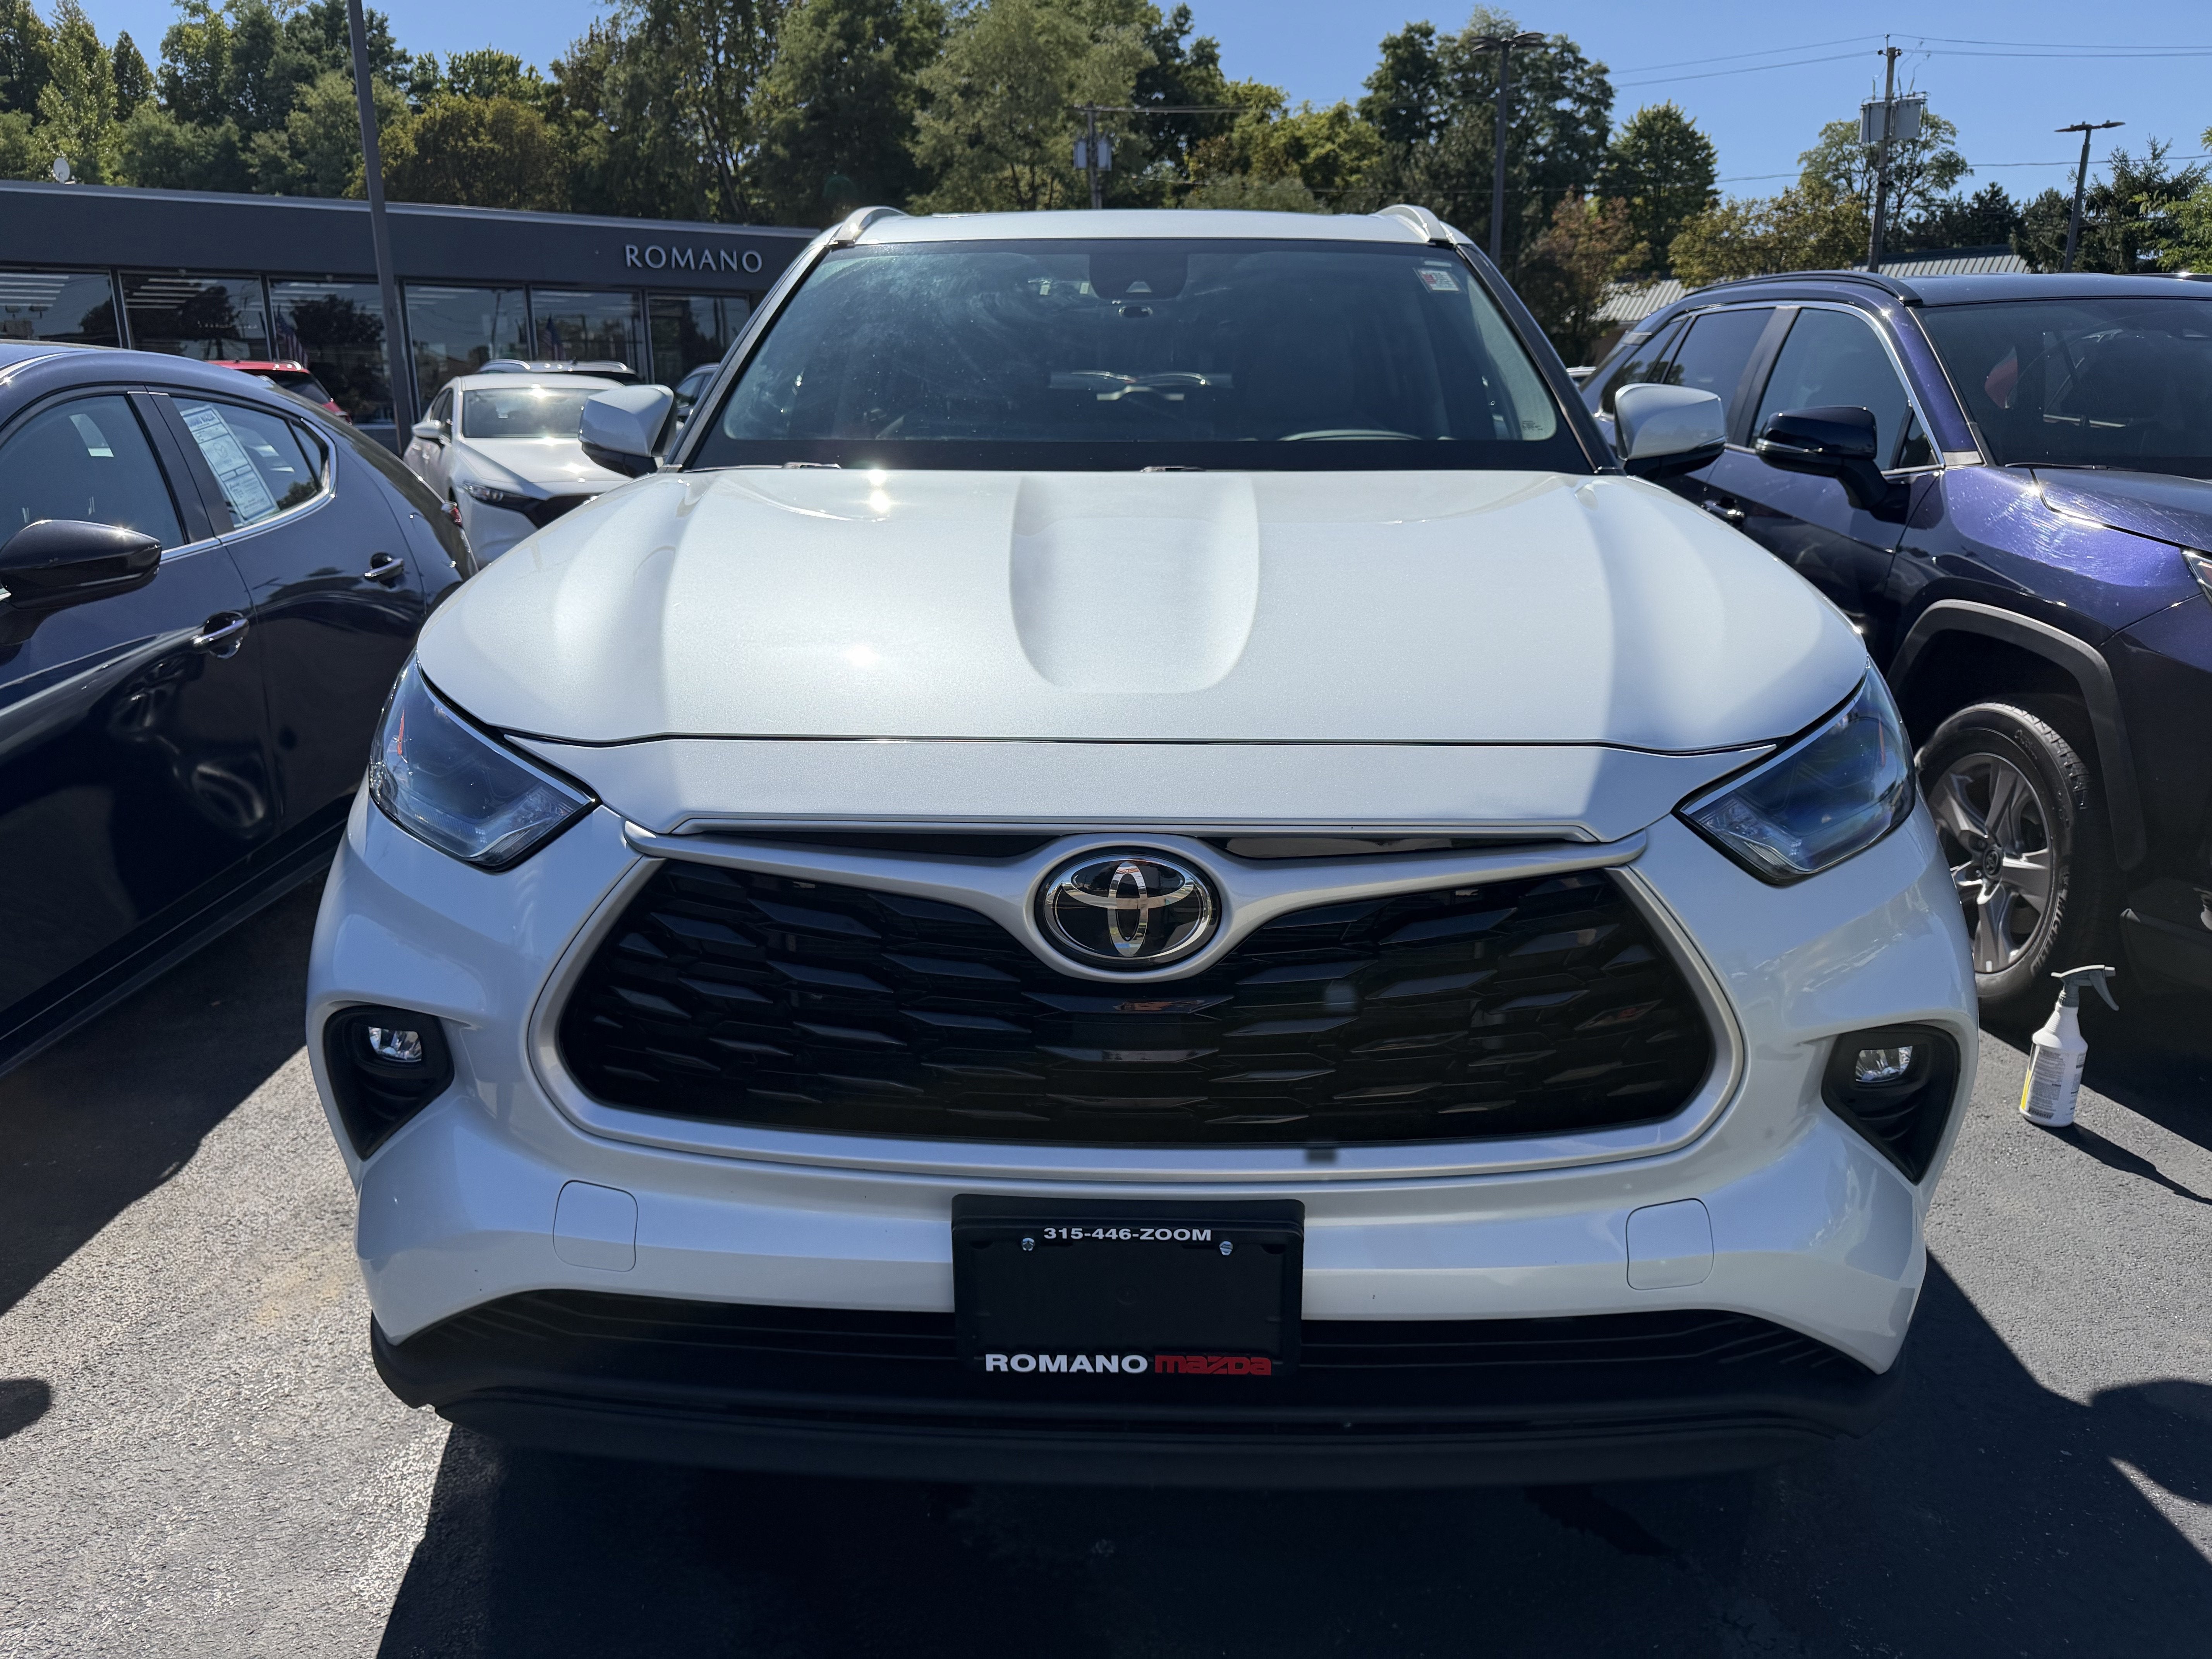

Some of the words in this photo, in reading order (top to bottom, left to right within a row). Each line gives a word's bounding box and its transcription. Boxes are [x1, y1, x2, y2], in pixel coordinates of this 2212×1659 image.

[625, 244, 763, 273] ROMANO
[1044, 1227, 1211, 1241] 315-446-ZOOM
[985, 1353, 1148, 1374] ROMANO
